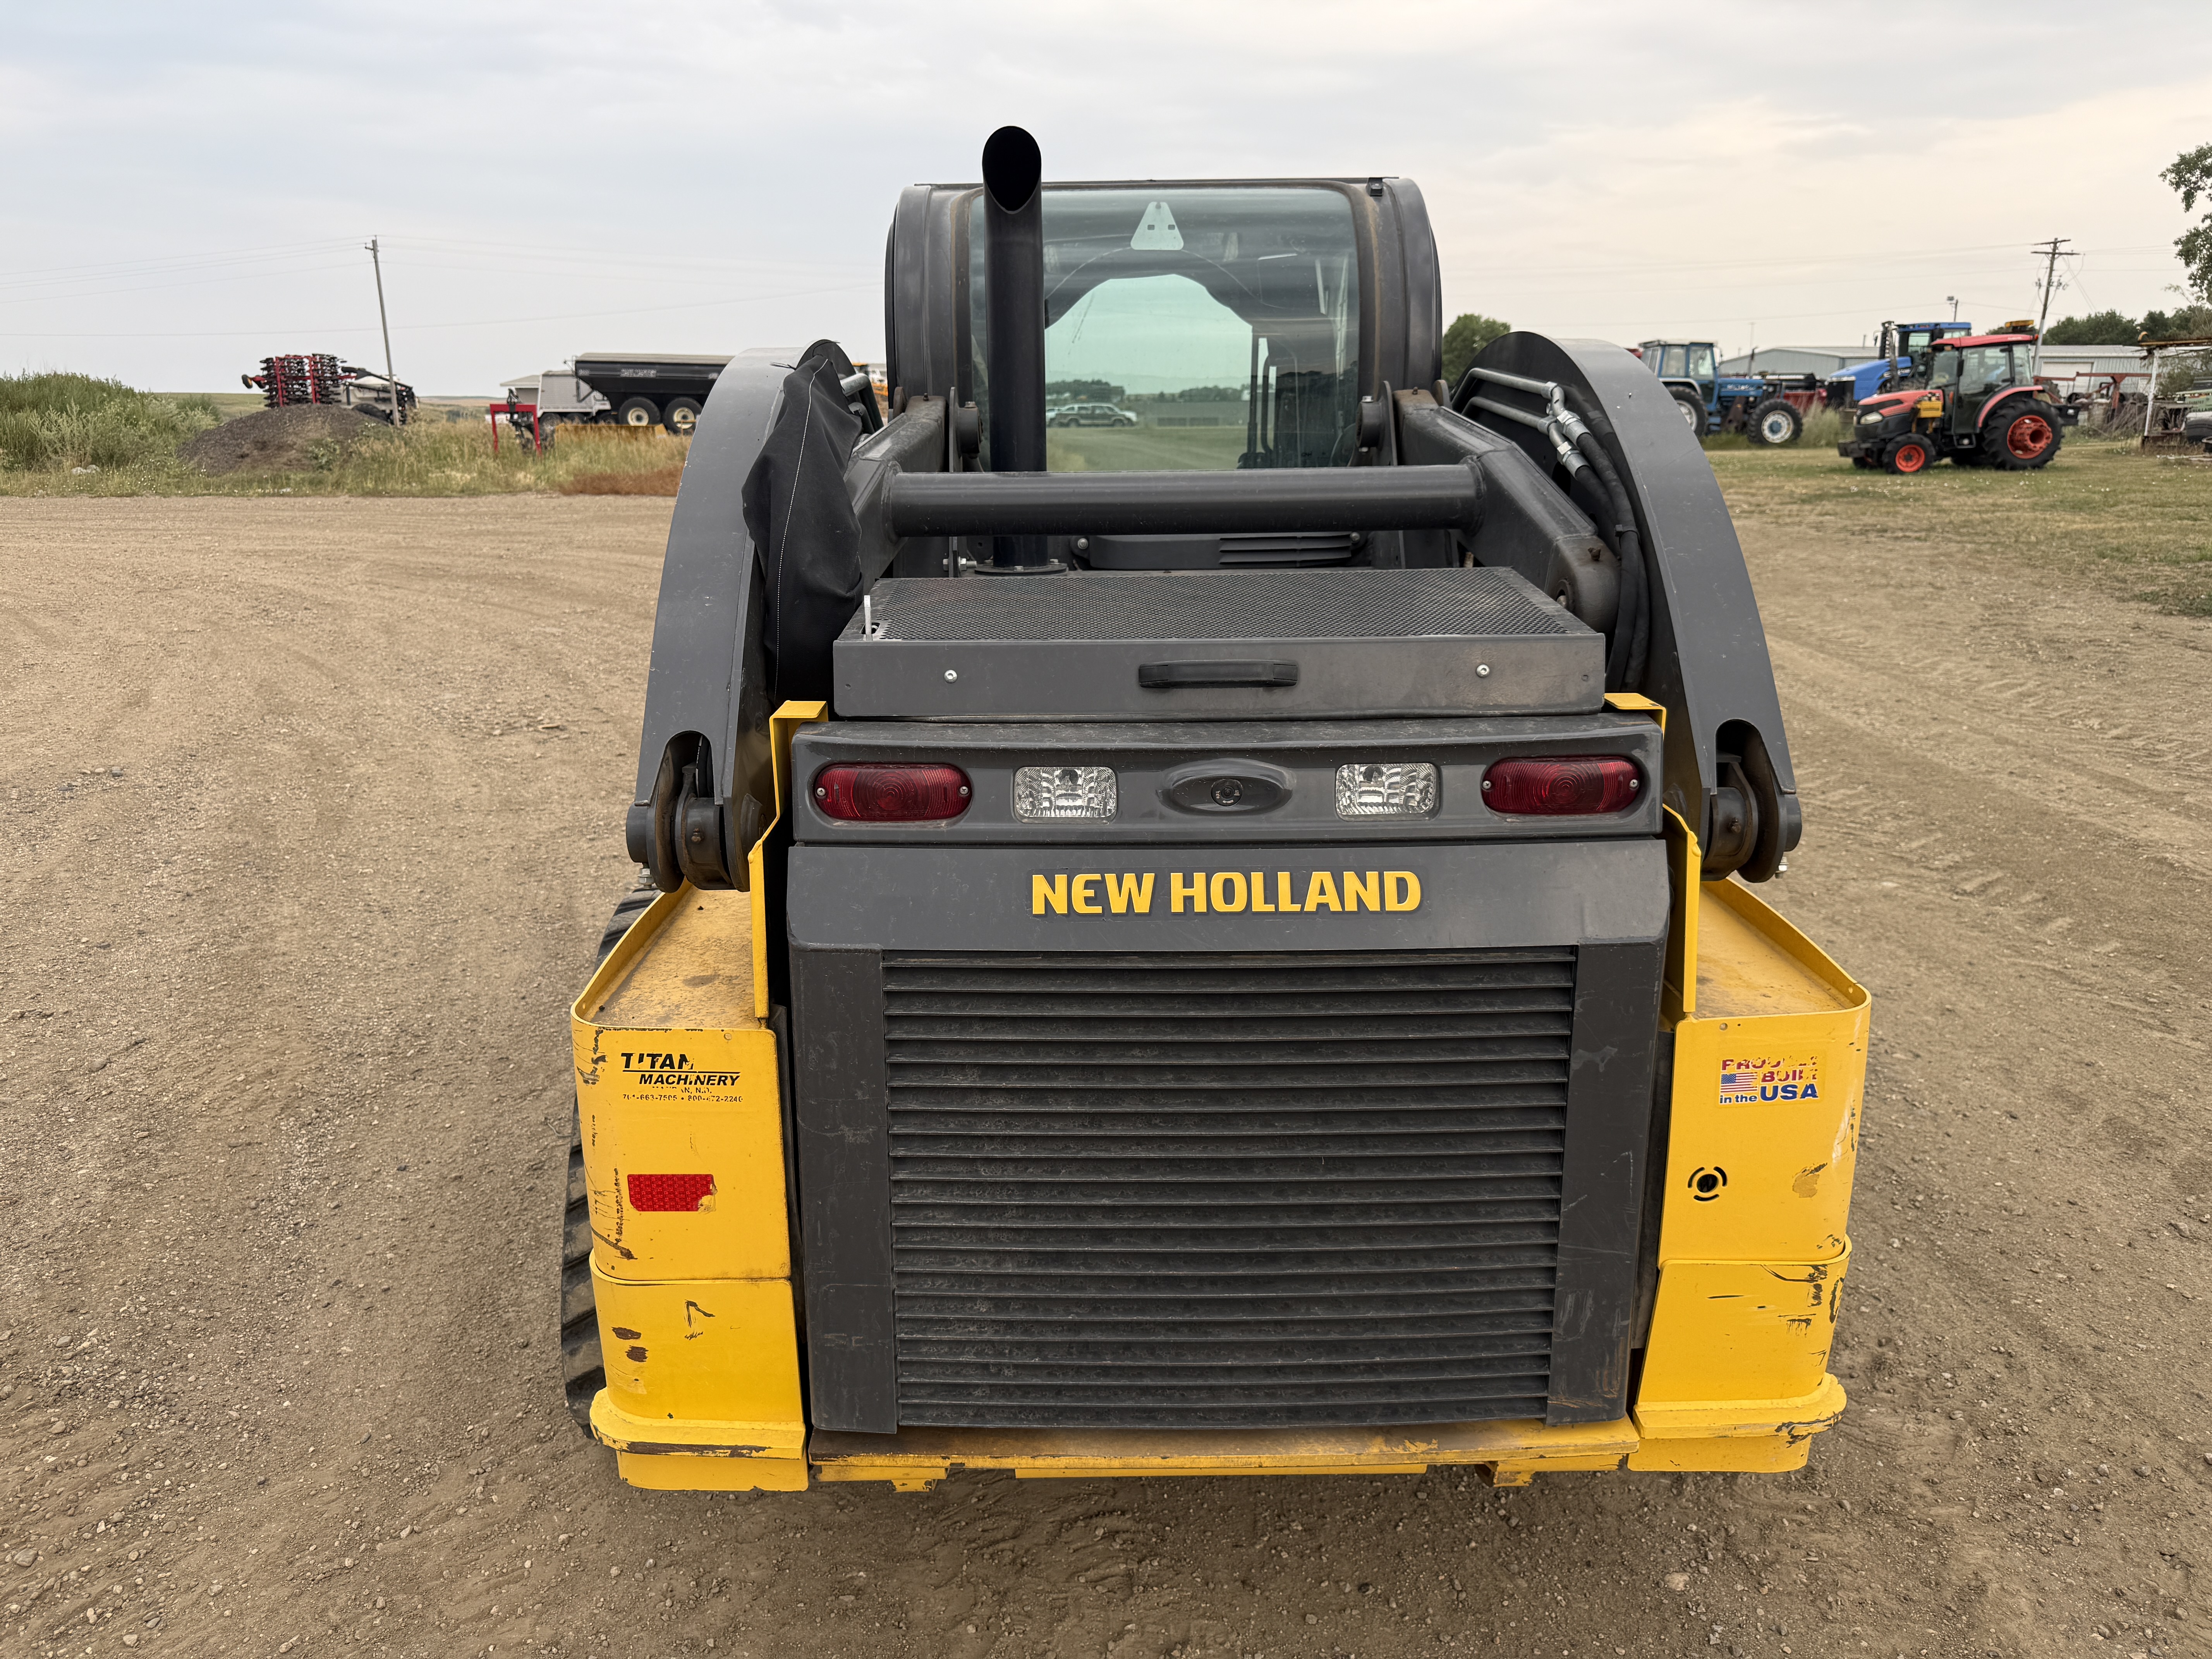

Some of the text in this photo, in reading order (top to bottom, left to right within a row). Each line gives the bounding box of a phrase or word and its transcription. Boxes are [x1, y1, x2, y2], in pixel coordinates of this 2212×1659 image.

[1033, 872, 1421, 914] NEW HOLLAND
[621, 1053, 694, 1070] TITAN
[639, 1074, 740, 1086] MACHINERY
[1720, 1083, 1819, 1103] in the USA
